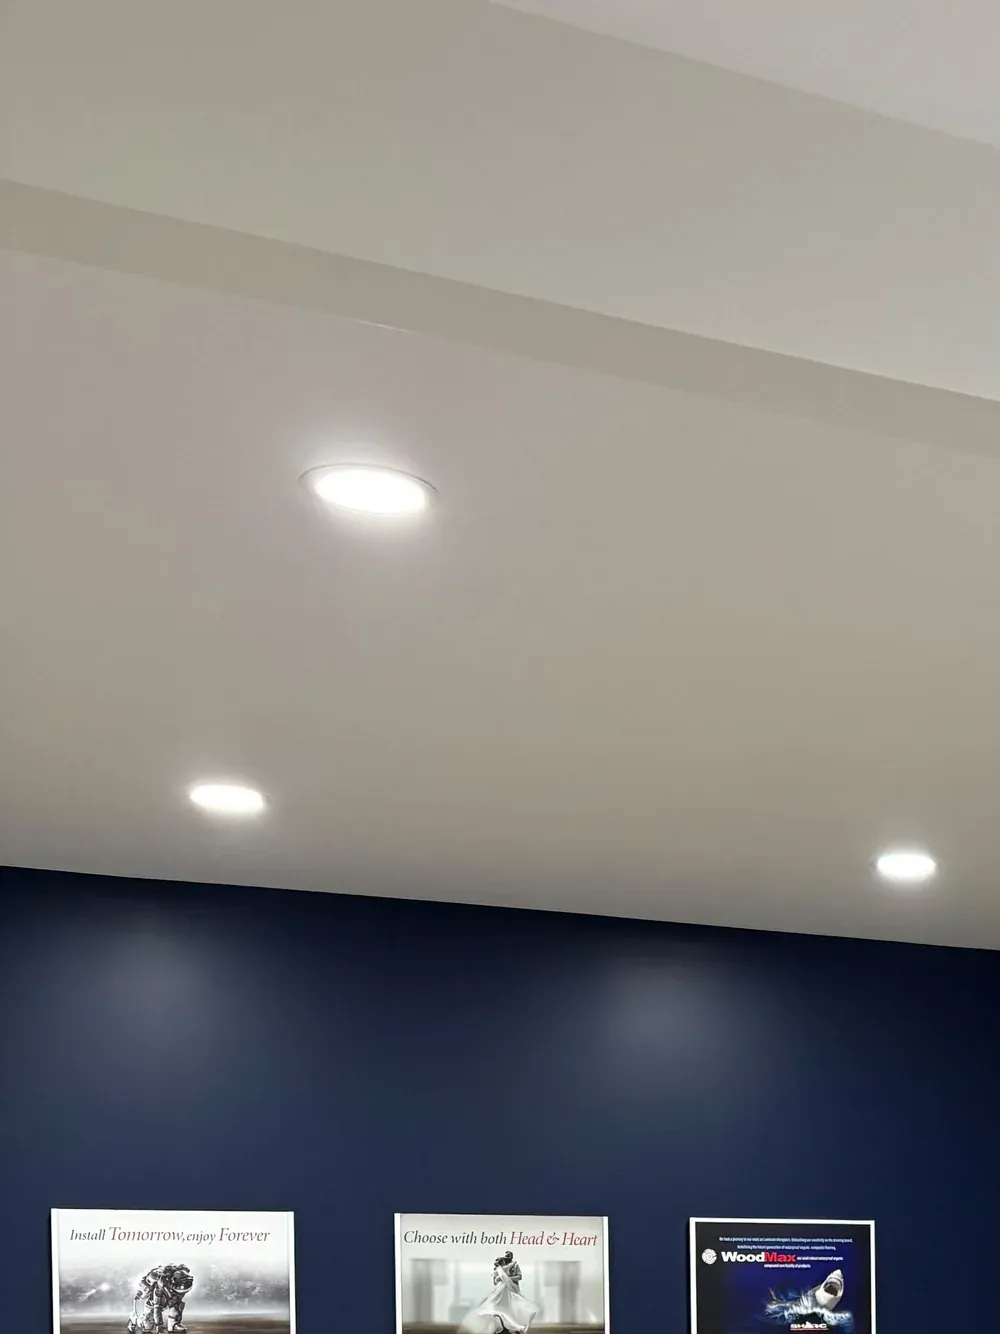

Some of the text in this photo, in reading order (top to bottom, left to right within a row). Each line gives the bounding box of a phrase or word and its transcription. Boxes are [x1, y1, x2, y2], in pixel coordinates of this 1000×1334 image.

[70, 1226, 270, 1245] Install Tomorrow, enjoy Forever
[404, 1230, 597, 1246] Choose with both Head & Heart
[721, 1251, 797, 1262] WoodMax
